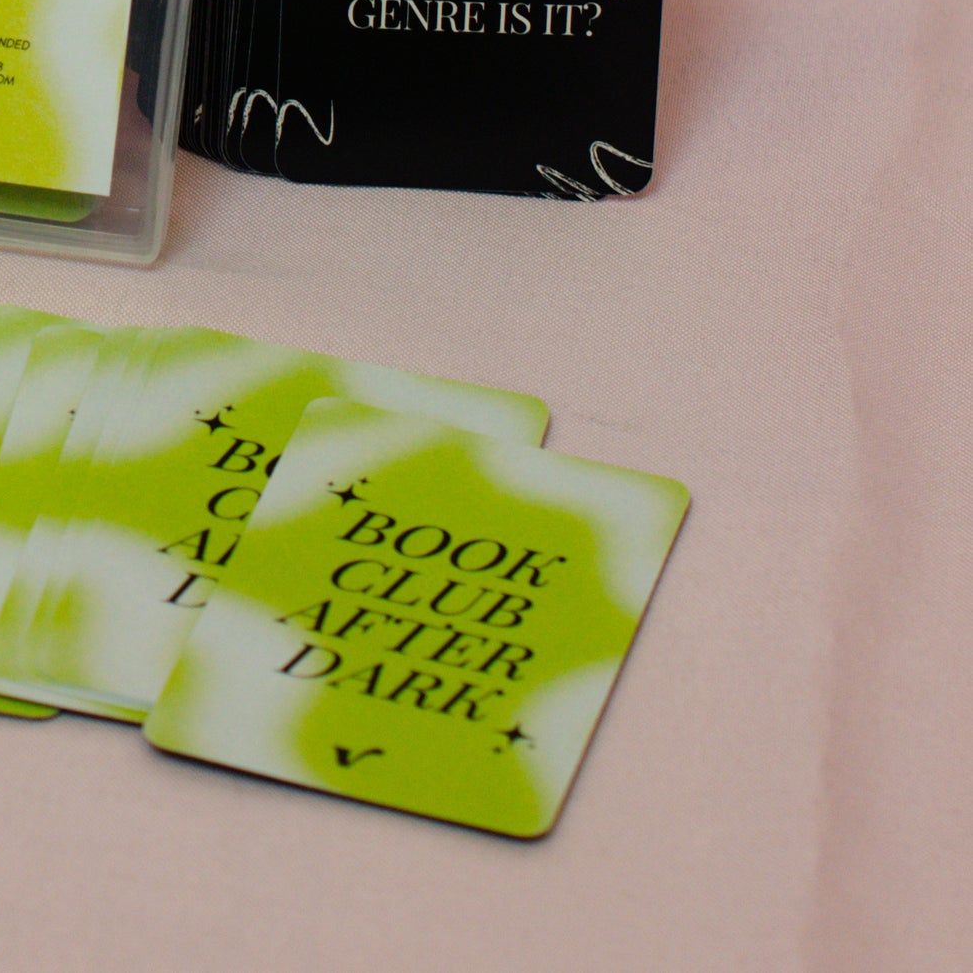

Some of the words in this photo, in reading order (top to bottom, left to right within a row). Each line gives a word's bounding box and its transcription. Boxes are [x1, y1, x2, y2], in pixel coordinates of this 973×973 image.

[496, 2, 532, 35] IS
[542, 1, 603, 37] IT?
[336, 510, 568, 588] BOOK
[330, 558, 534, 629] CLUB
[275, 599, 534, 682] AFTER
[275, 643, 505, 722] DARK
